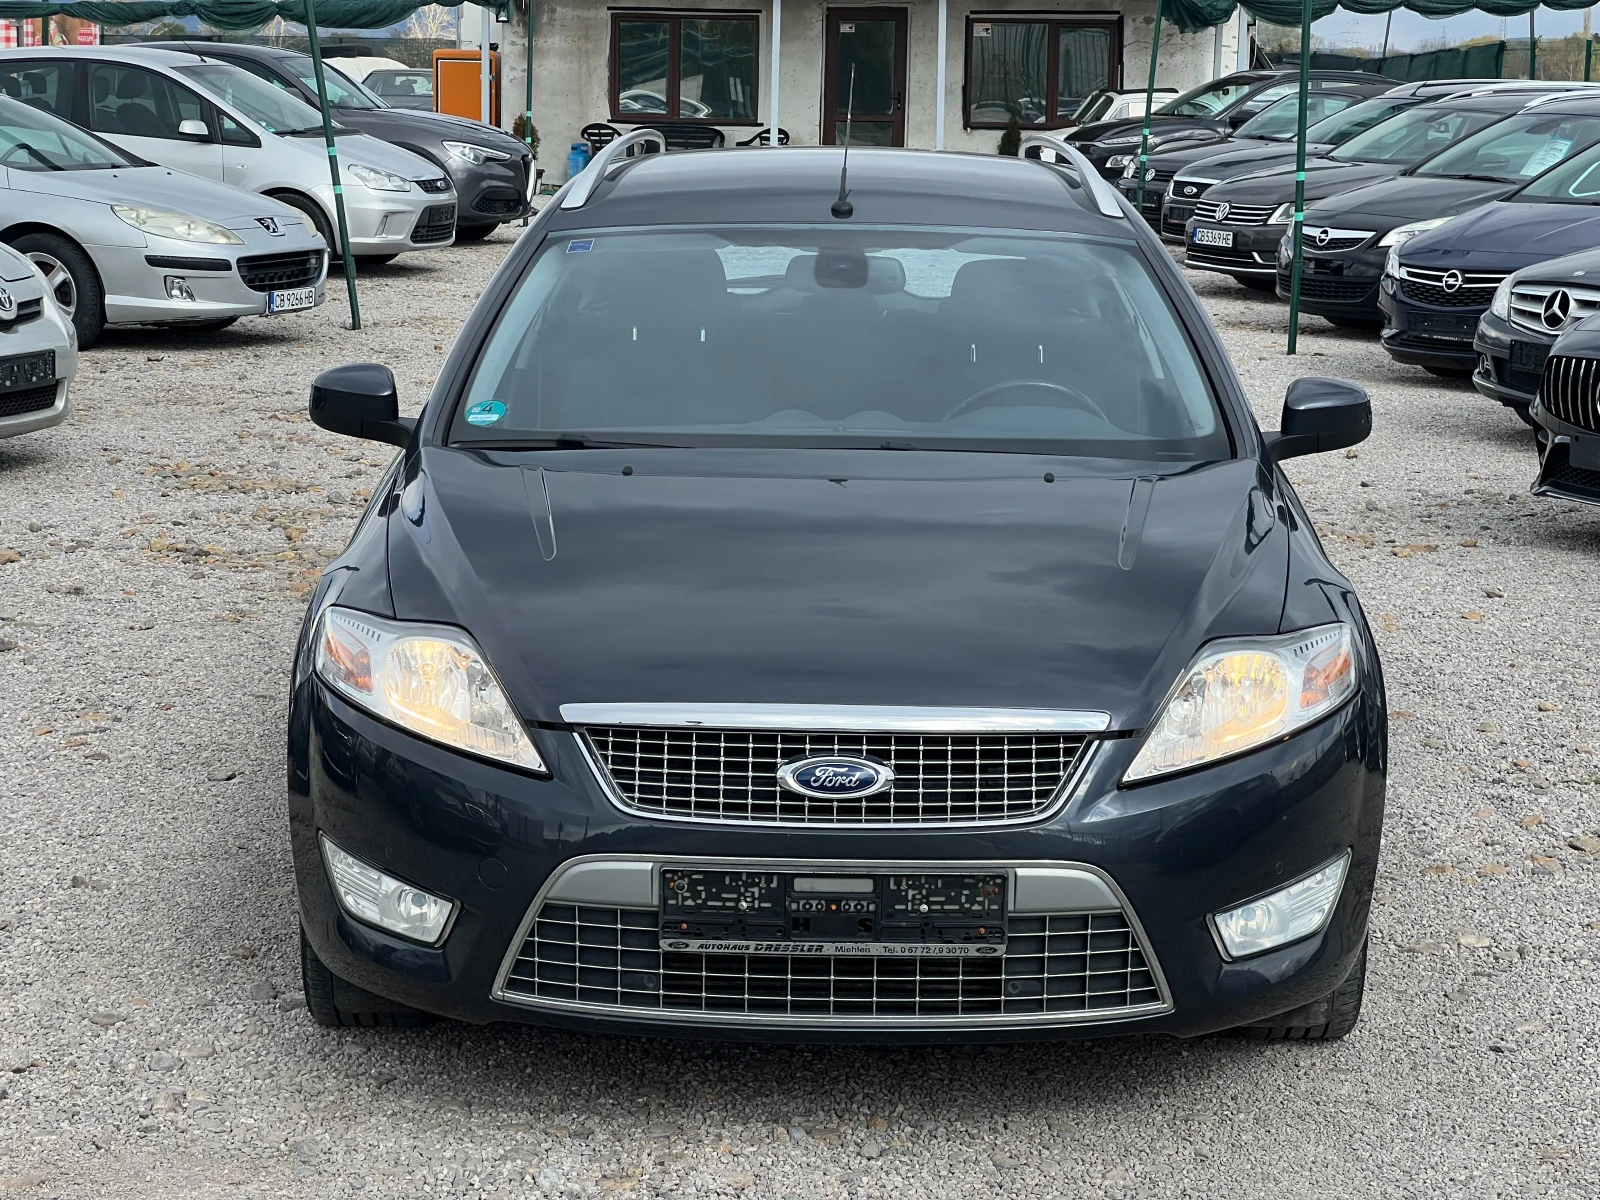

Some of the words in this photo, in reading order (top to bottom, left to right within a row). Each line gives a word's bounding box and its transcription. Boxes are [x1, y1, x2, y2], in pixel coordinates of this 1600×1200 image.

[1222, 233, 1232, 245] HE
[275, 293, 285, 308] CB
[286, 291, 303, 307] 9266
[304, 290, 314, 304] HB
[481, 401, 494, 413] 4
[810, 766, 860, 787] Ford
[697, 943, 750, 951] AUTOHAUS
[753, 943, 825, 953] DRESSLER
[883, 946, 898, 954] Tel.
